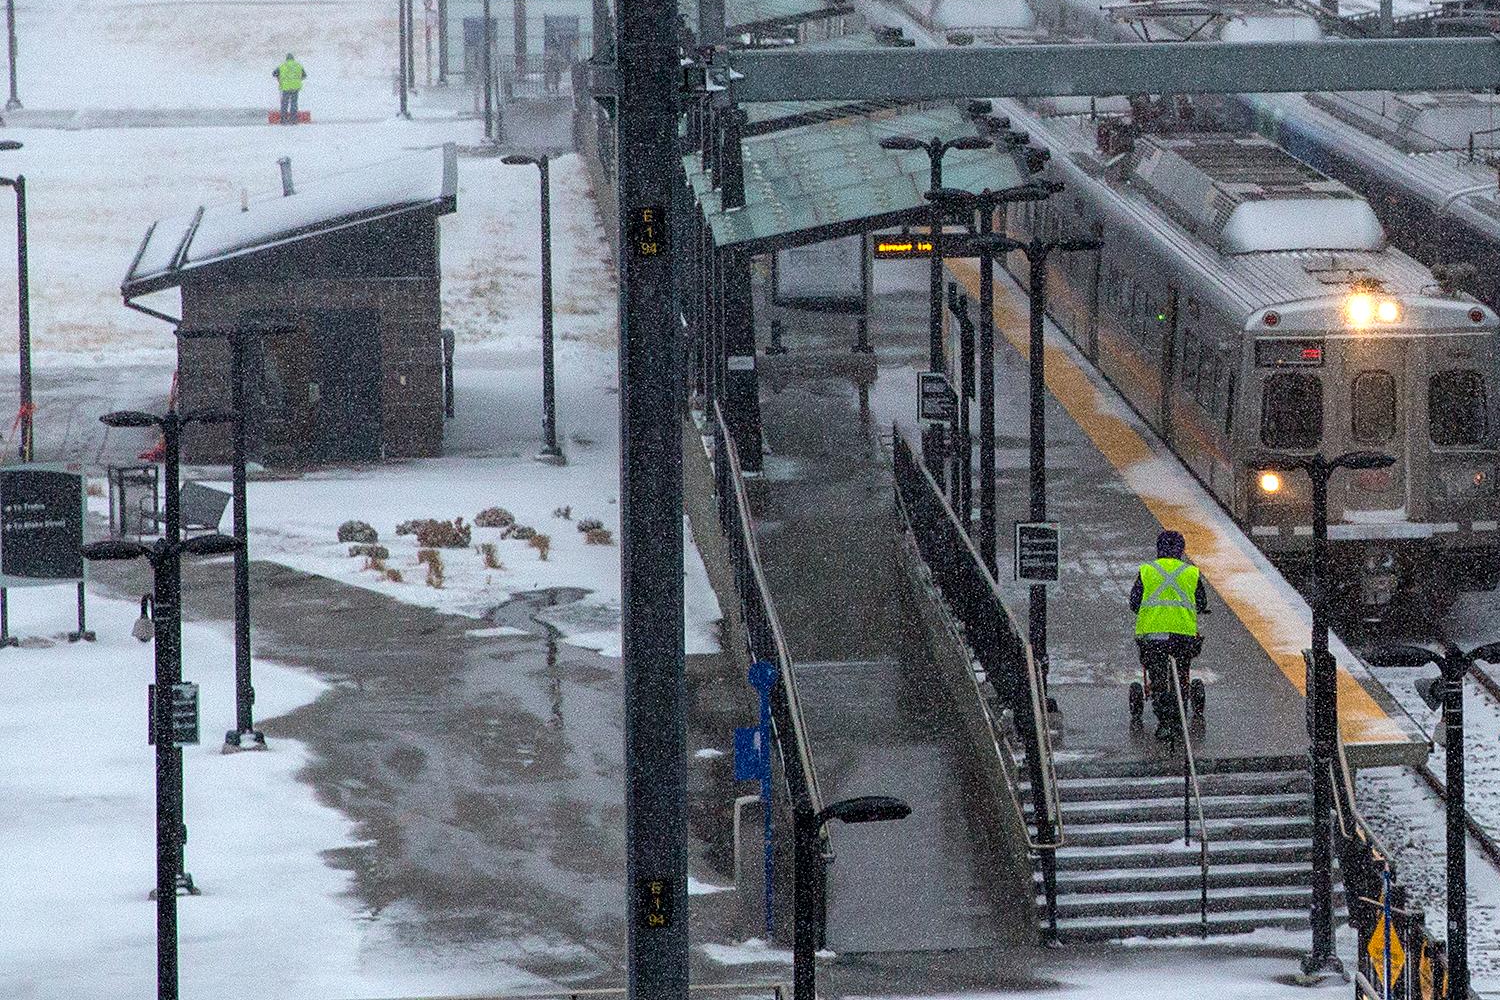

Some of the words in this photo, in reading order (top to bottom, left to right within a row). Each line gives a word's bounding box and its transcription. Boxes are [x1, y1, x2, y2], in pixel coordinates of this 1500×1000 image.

[643, 208, 653, 222] E
[641, 242, 657, 256] 94
[649, 913, 665, 926] 94
